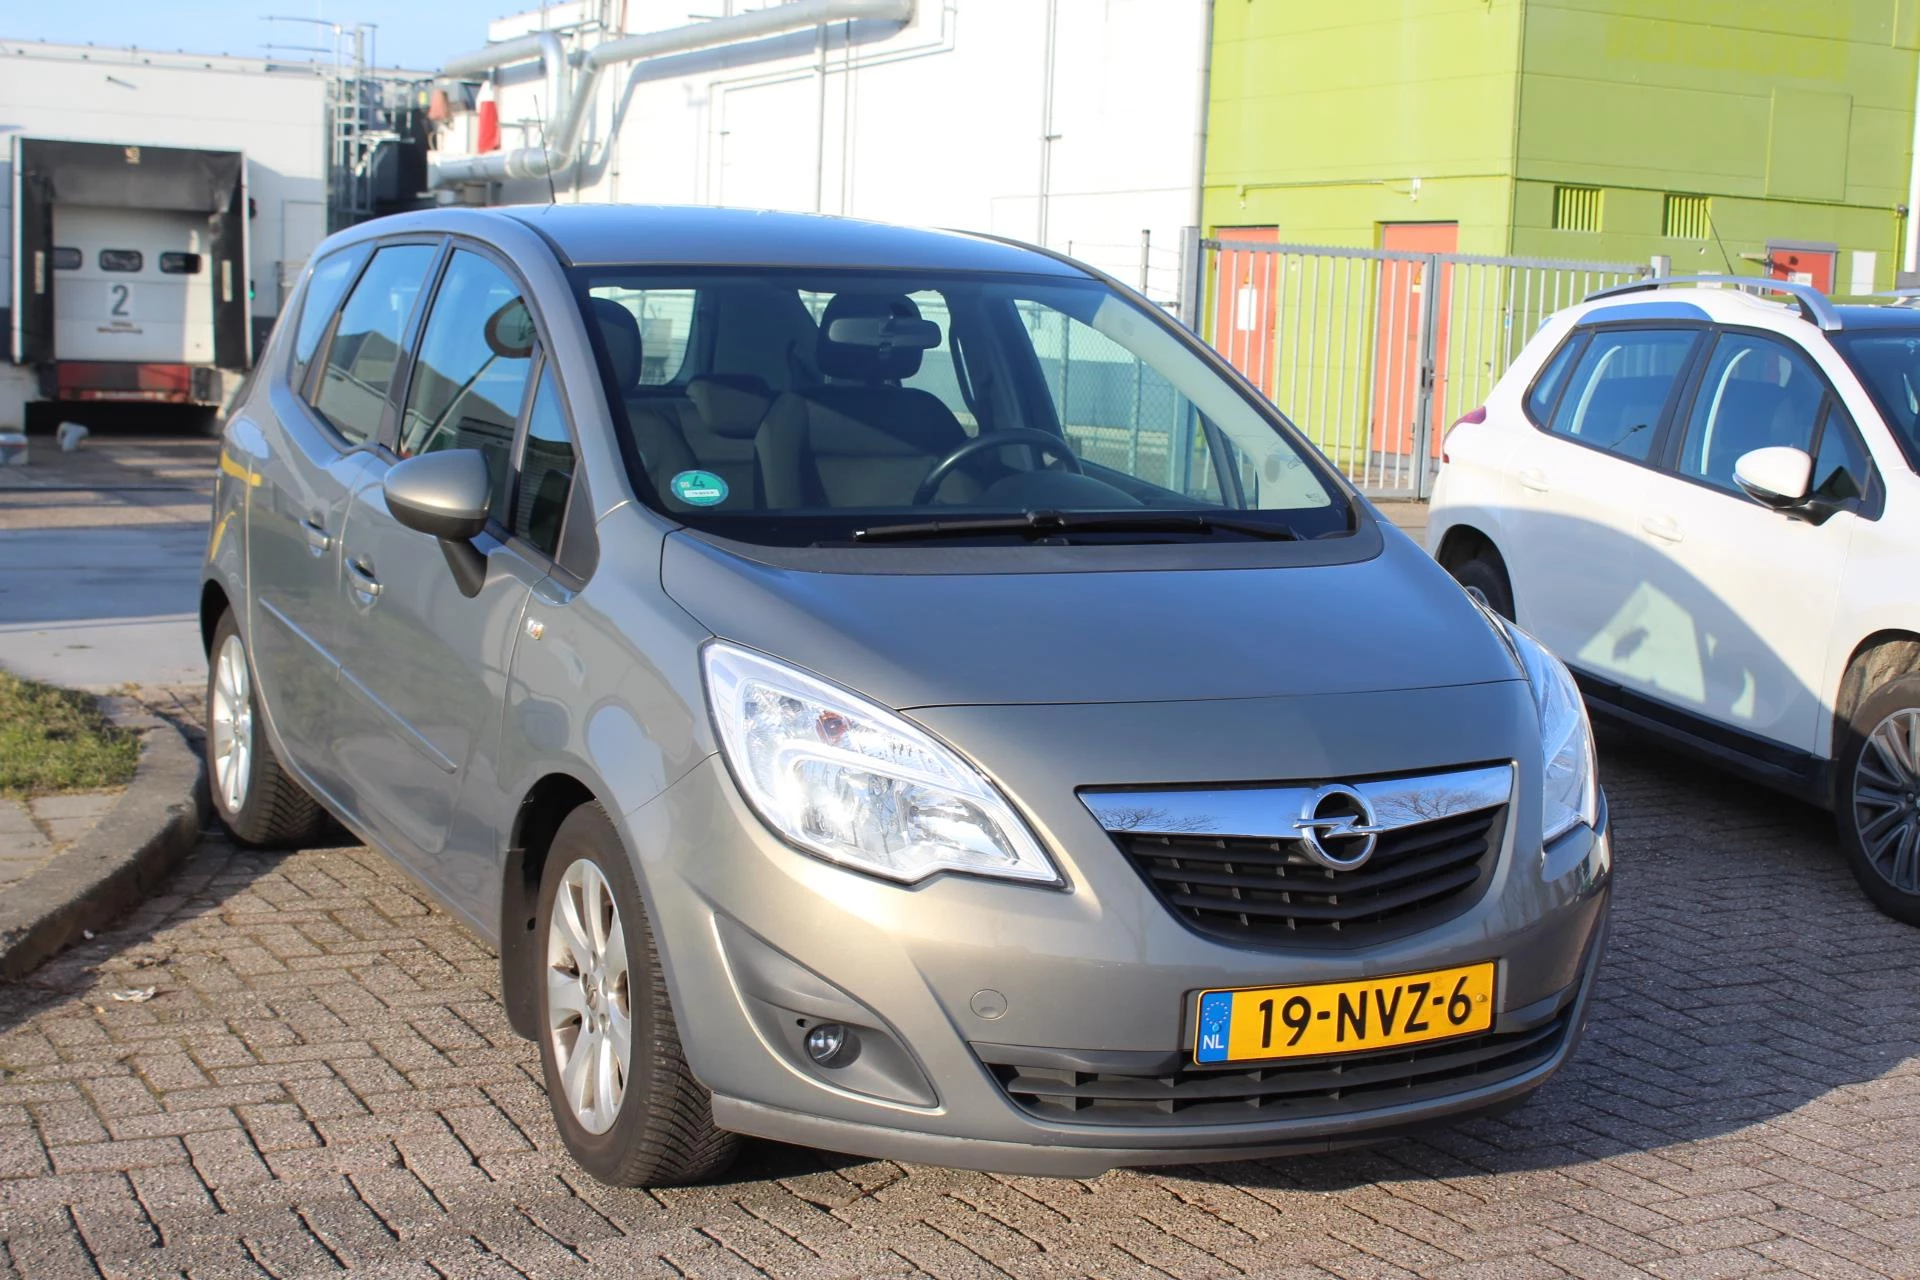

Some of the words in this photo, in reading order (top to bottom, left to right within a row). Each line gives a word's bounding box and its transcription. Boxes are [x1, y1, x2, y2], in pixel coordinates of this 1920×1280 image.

[111, 284, 130, 316] 2
[1259, 976, 1472, 1049] 19-NVZ-6
[1203, 1034, 1224, 1050] NL
